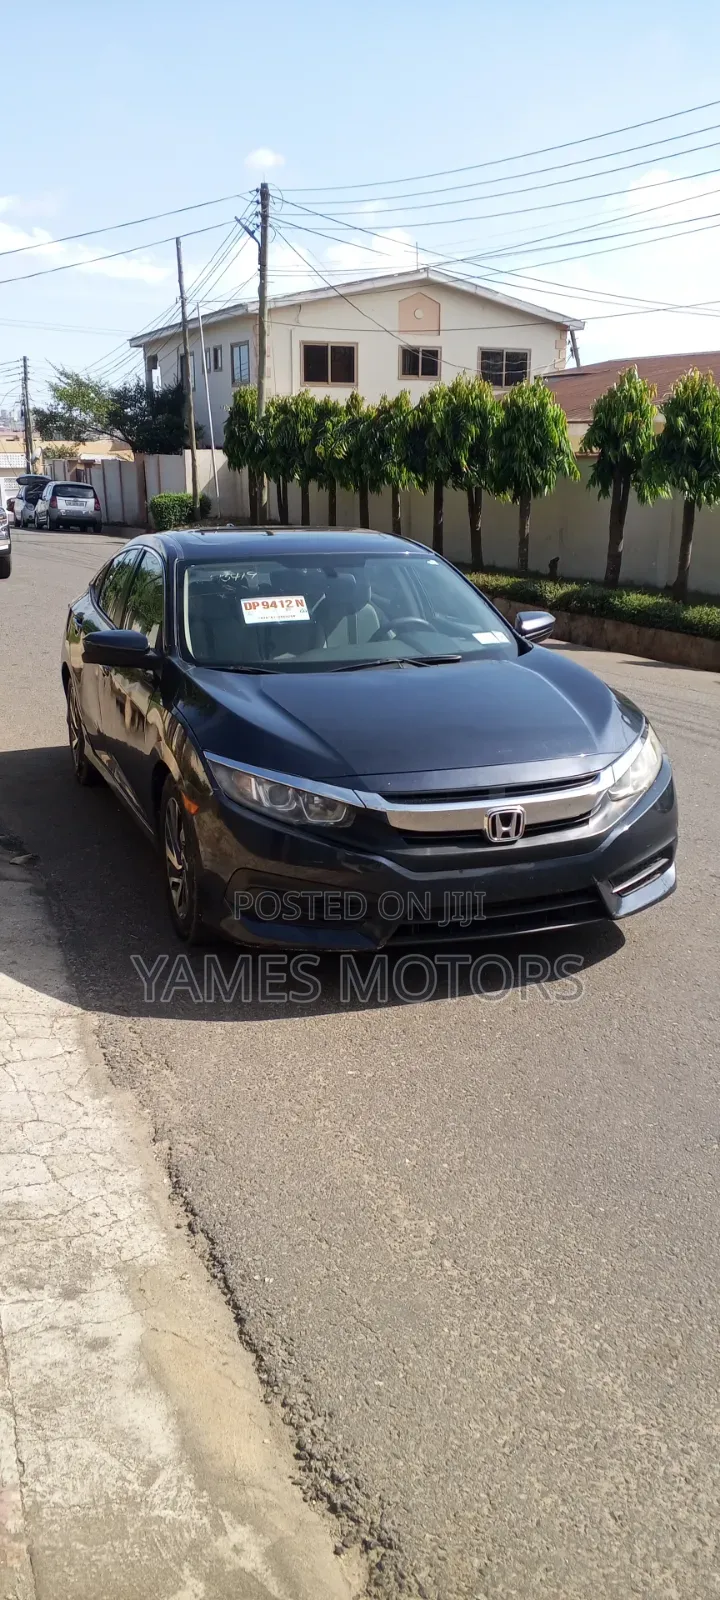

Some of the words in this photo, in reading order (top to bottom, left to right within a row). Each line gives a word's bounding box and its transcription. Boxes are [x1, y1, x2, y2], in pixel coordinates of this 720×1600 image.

[243, 601, 260, 611] DP
[261, 599, 294, 610] 9412
[295, 598, 305, 608] N
